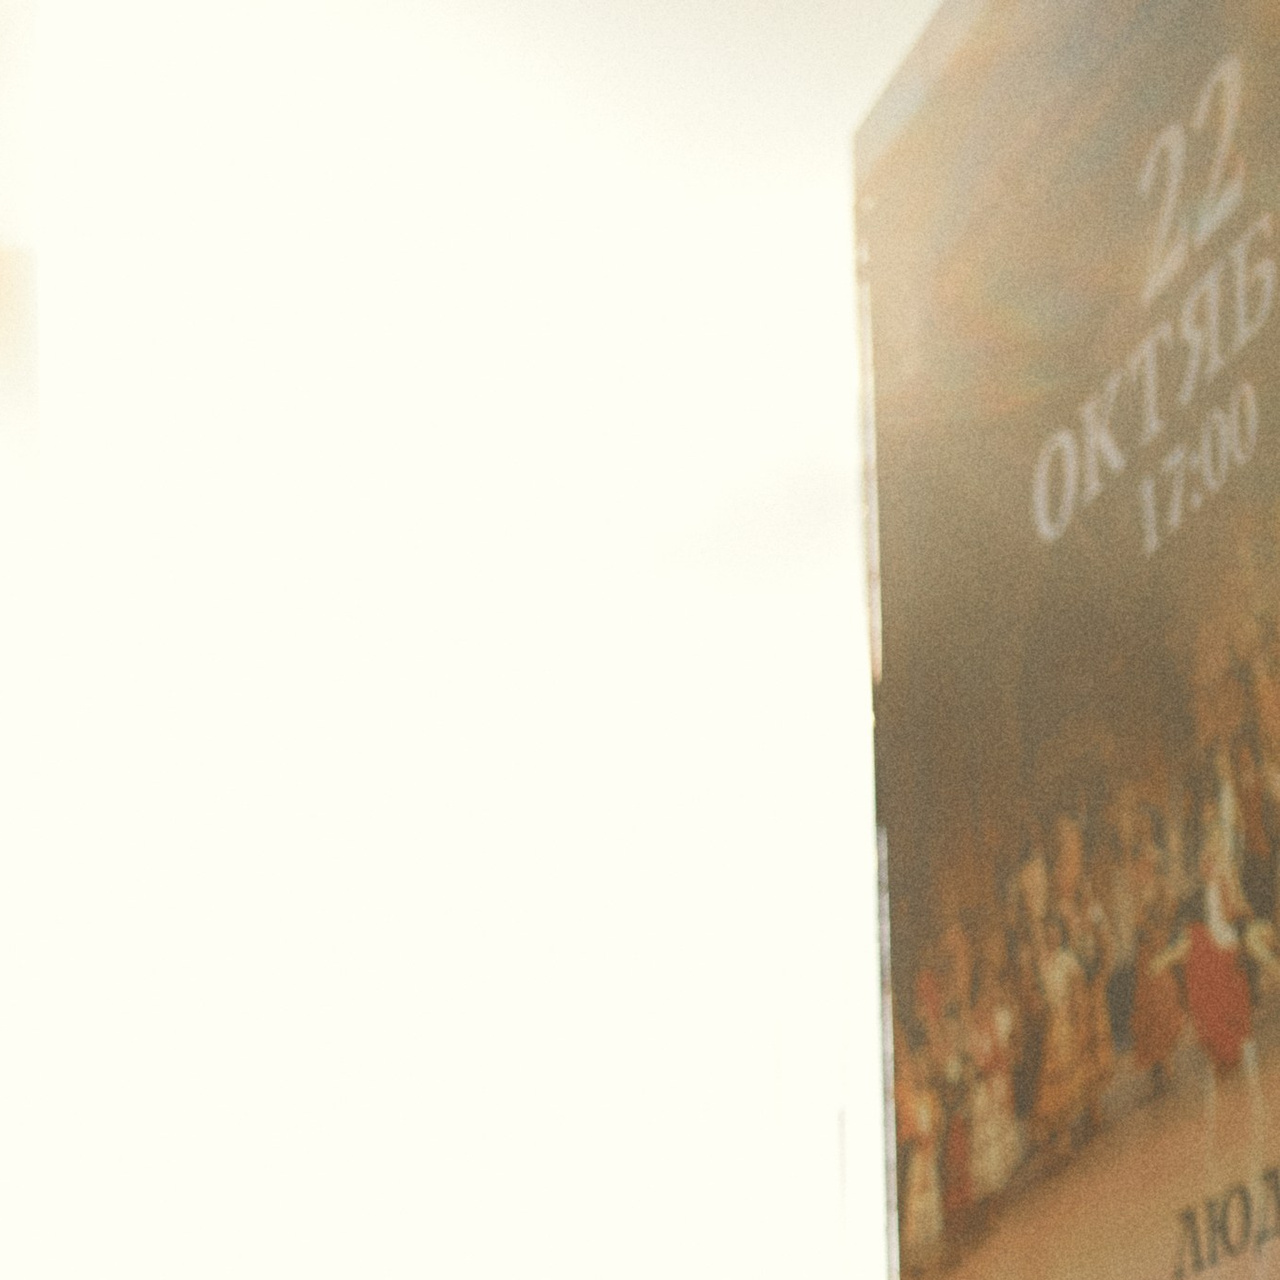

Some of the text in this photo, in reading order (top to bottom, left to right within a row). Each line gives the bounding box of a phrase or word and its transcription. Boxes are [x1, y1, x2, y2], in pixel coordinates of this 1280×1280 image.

[1138, 57, 1243, 302] 22
[1032, 212, 1277, 542] ОКТЯБ
[1140, 382, 1258, 556] 17:00
